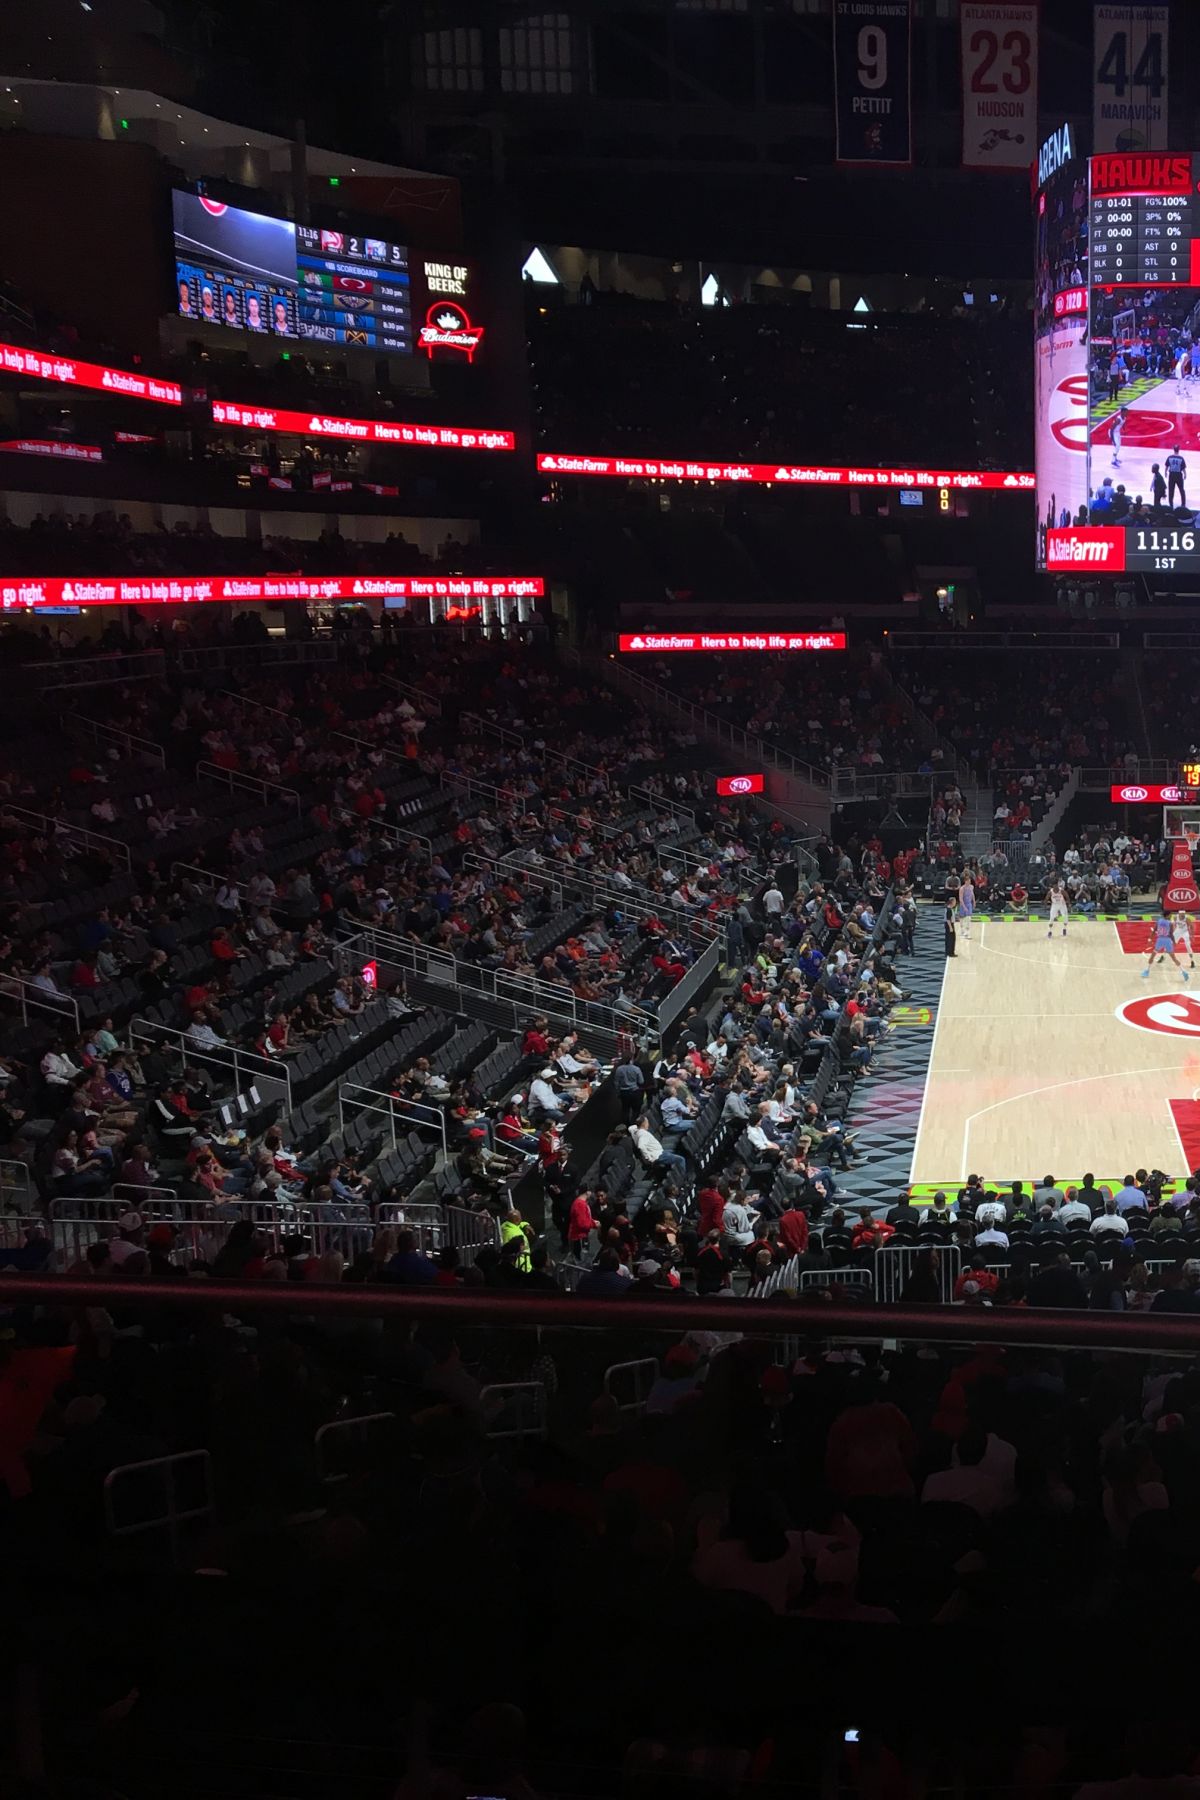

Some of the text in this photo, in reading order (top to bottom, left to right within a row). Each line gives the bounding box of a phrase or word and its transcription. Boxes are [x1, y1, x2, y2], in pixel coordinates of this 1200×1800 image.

[851, 4, 874, 16] LOUIS
[876, 5, 907, 17] HAWKS
[965, 8, 1033, 22] ATLANTA HAWKS
[1098, 8, 1166, 22] ATLANTA HAWKS
[857, 25, 888, 90] 9
[969, 29, 1032, 95] 23
[1097, 31, 1166, 98] 44
[852, 97, 892, 114] PETTIT
[977, 101, 1025, 118] HUDSON
[1101, 103, 1162, 121] MARAVICH
[1037, 122, 1072, 187] ARENA
[1092, 158, 1191, 188] HAWKS
[1094, 197, 1187, 208] FG 01-01 FG% 100%
[1094, 212, 1181, 223] 3P 00-00 3P% 0%
[299, 227, 319, 240] 11:16
[1094, 227, 1181, 238] FT 00-00 FT% 0%
[393, 246, 400, 259] 5
[1145, 243, 1159, 251] AST
[1094, 258, 1159, 267] BLK STL
[336, 263, 378, 278] SCOREBOARD
[424, 262, 452, 279] KING
[453, 266, 467, 281] OF
[1094, 273, 1159, 282] TO FLS
[428, 276, 466, 295] BEERS.
[420, 327, 479, 344] Budweiser
[375, 425, 399, 439] Here
[402, 428, 413, 440] to
[416, 428, 437, 443] help
[441, 430, 458, 443] life
[462, 435, 475, 446] go
[616, 461, 642, 473] Here
[646, 464, 657, 474] to
[661, 463, 683, 476] help
[687, 465, 703, 476] life
[707, 468, 720, 478] go
[1137, 531, 1195, 551] 11:16
[1155, 558, 1176, 569] 1ST
[412, 581, 433, 593] Here
[436, 582, 446, 593] to
[450, 581, 470, 596] help
[474, 581, 488, 593] life
[492, 584, 505, 596] go
[702, 637, 725, 647] Here
[729, 637, 739, 647] to
[743, 637, 766, 648] help
[770, 636, 785, 647] life
[789, 639, 802, 648] go
